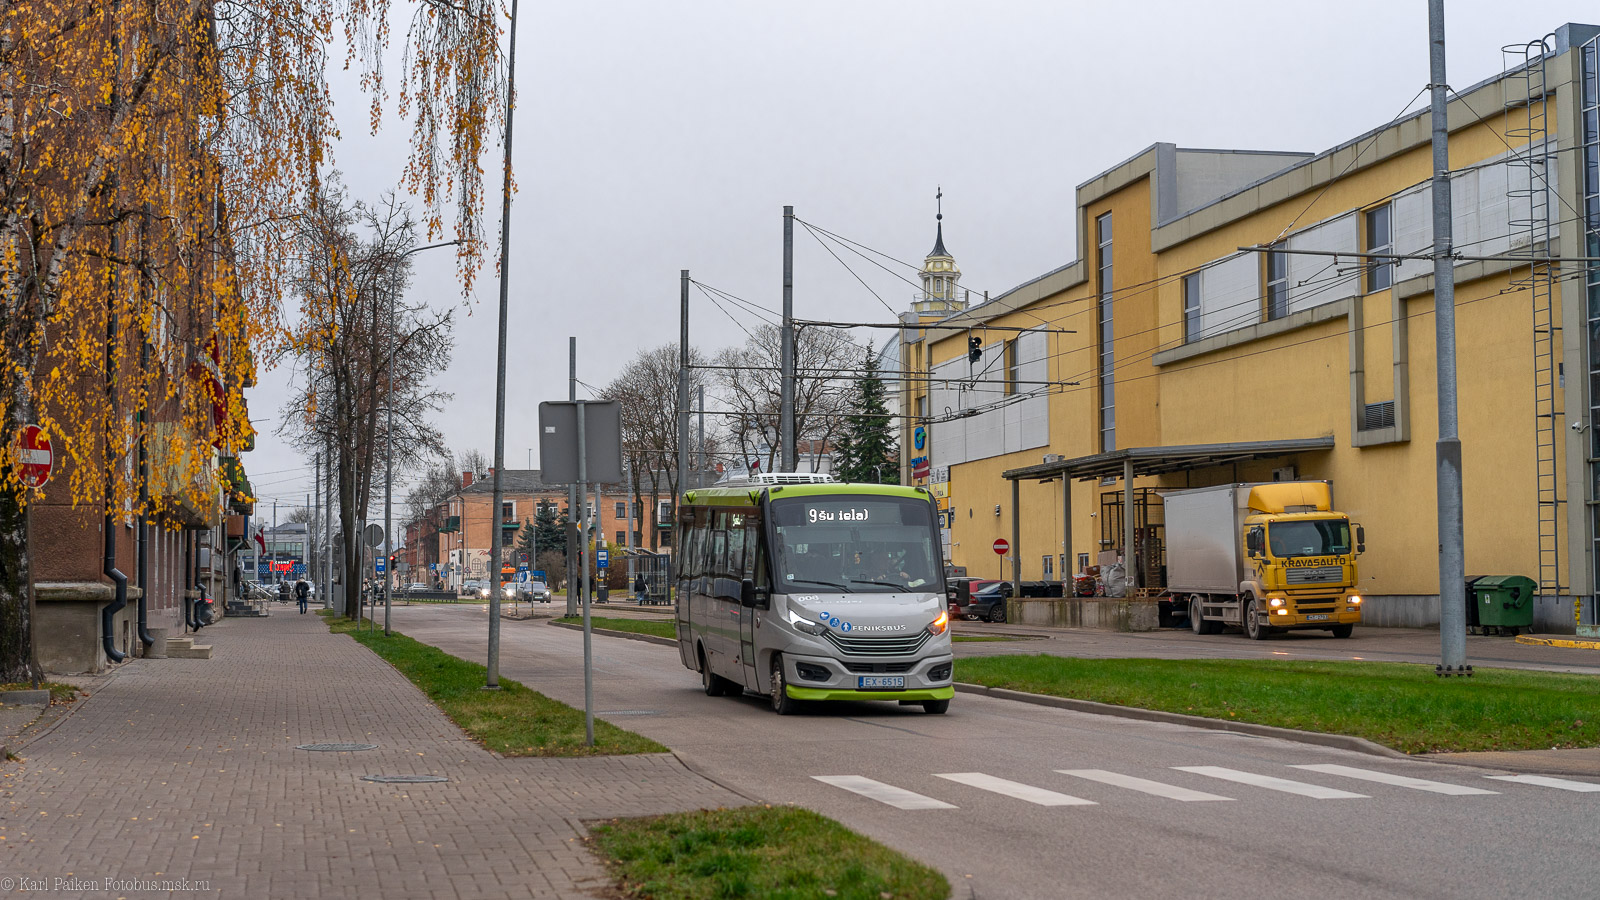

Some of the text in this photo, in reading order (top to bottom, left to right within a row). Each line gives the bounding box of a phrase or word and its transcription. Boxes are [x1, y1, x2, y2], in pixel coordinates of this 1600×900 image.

[809, 508, 869, 523] 9 šu iela)
[1281, 558, 1346, 568] KRAVASAUTO
[852, 624, 906, 632] FENIKSBUS
[865, 677, 903, 686] EX-6515
